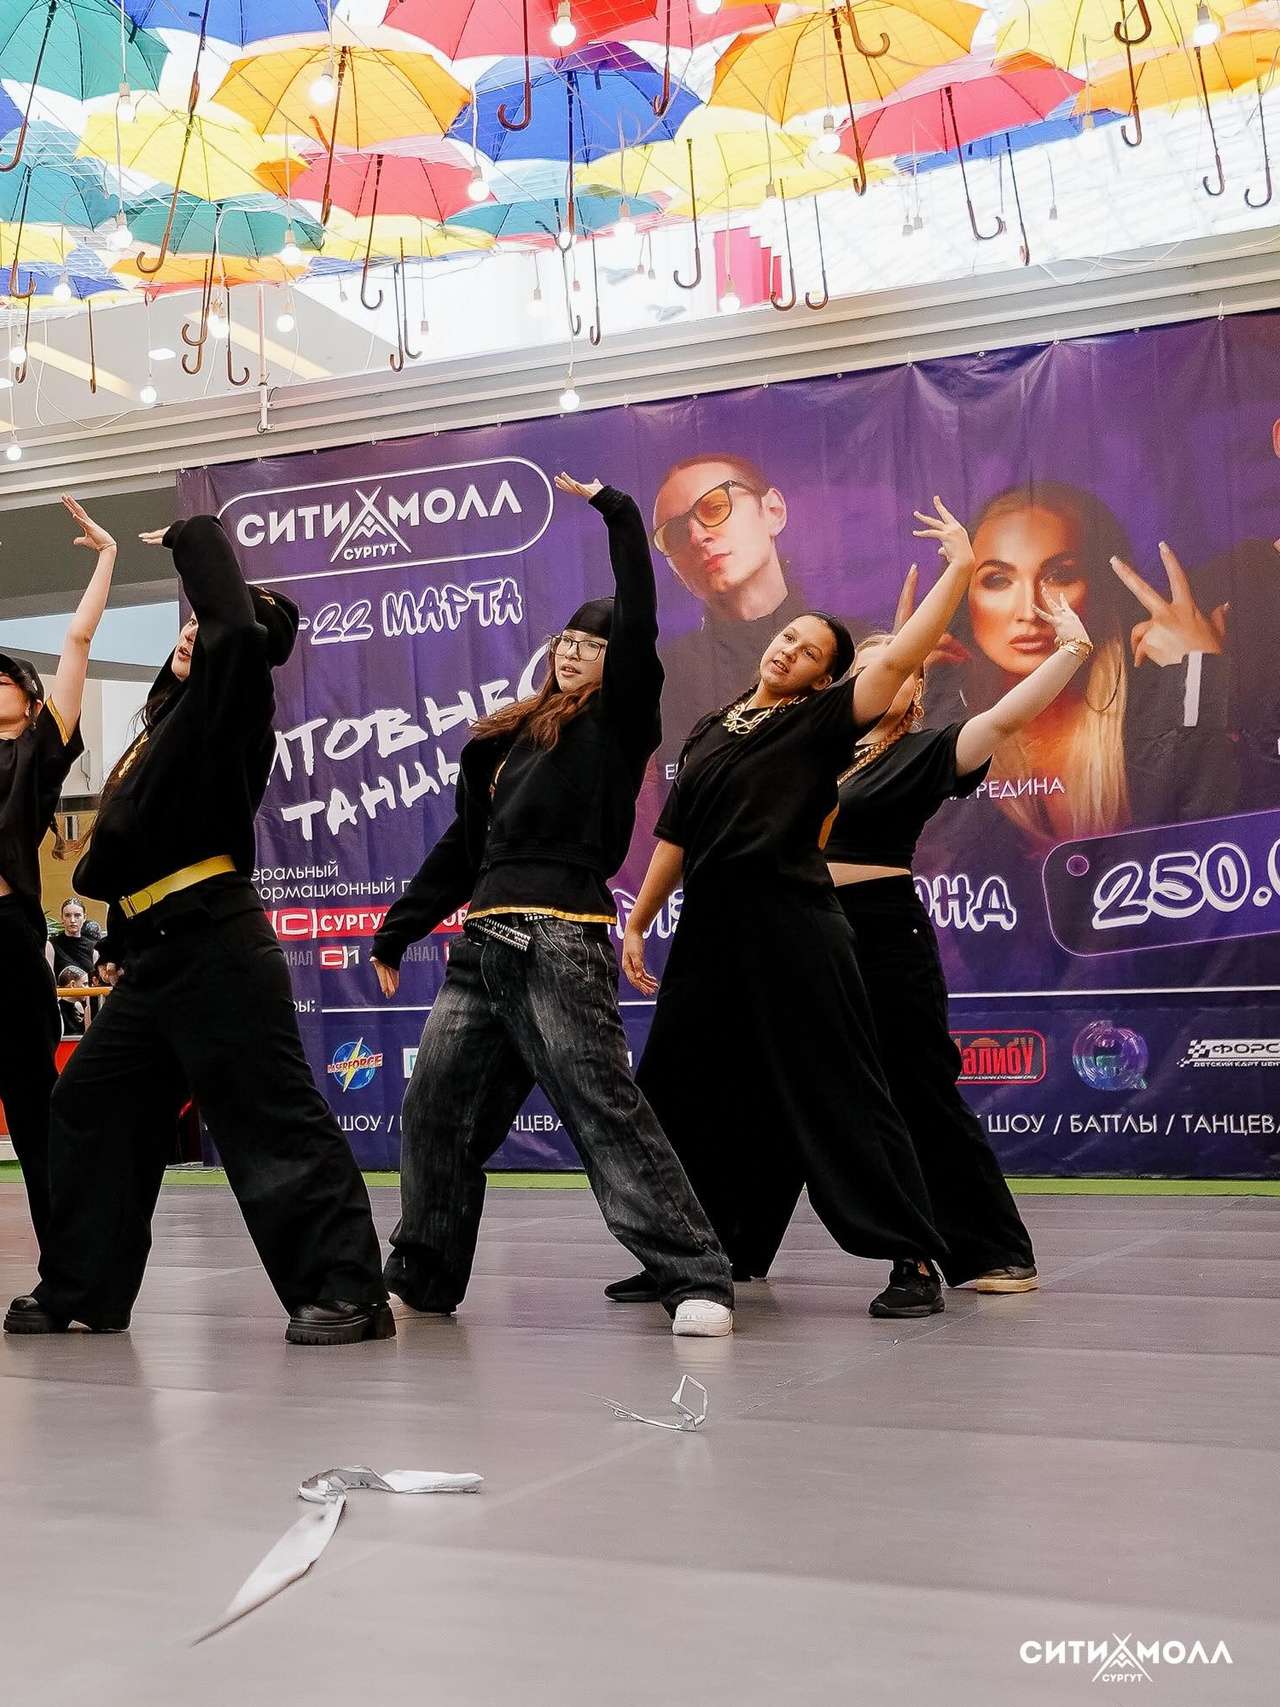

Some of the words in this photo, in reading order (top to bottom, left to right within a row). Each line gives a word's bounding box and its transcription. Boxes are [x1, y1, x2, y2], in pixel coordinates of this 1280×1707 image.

[236, 503, 351, 548] СИТИ
[387, 479, 523, 528] МОЛЛ
[343, 543, 398, 561] СУРГУТ
[298, 600, 374, 646] -22
[381, 577, 523, 638] МАРТА
[976, 776, 1066, 799] РЕДИНА
[250, 860, 339, 885] еральный
[257, 877, 396, 904] ормационный
[1092, 839, 1280, 930] 250.
[1211, 1043, 1280, 1055] ФОРС
[326, 1053, 383, 1074] LASERFORCE
[337, 1114, 382, 1132] ШОУ
[987, 1113, 1046, 1133] ШОУ
[1070, 1113, 1158, 1133] БАТТЛЫ
